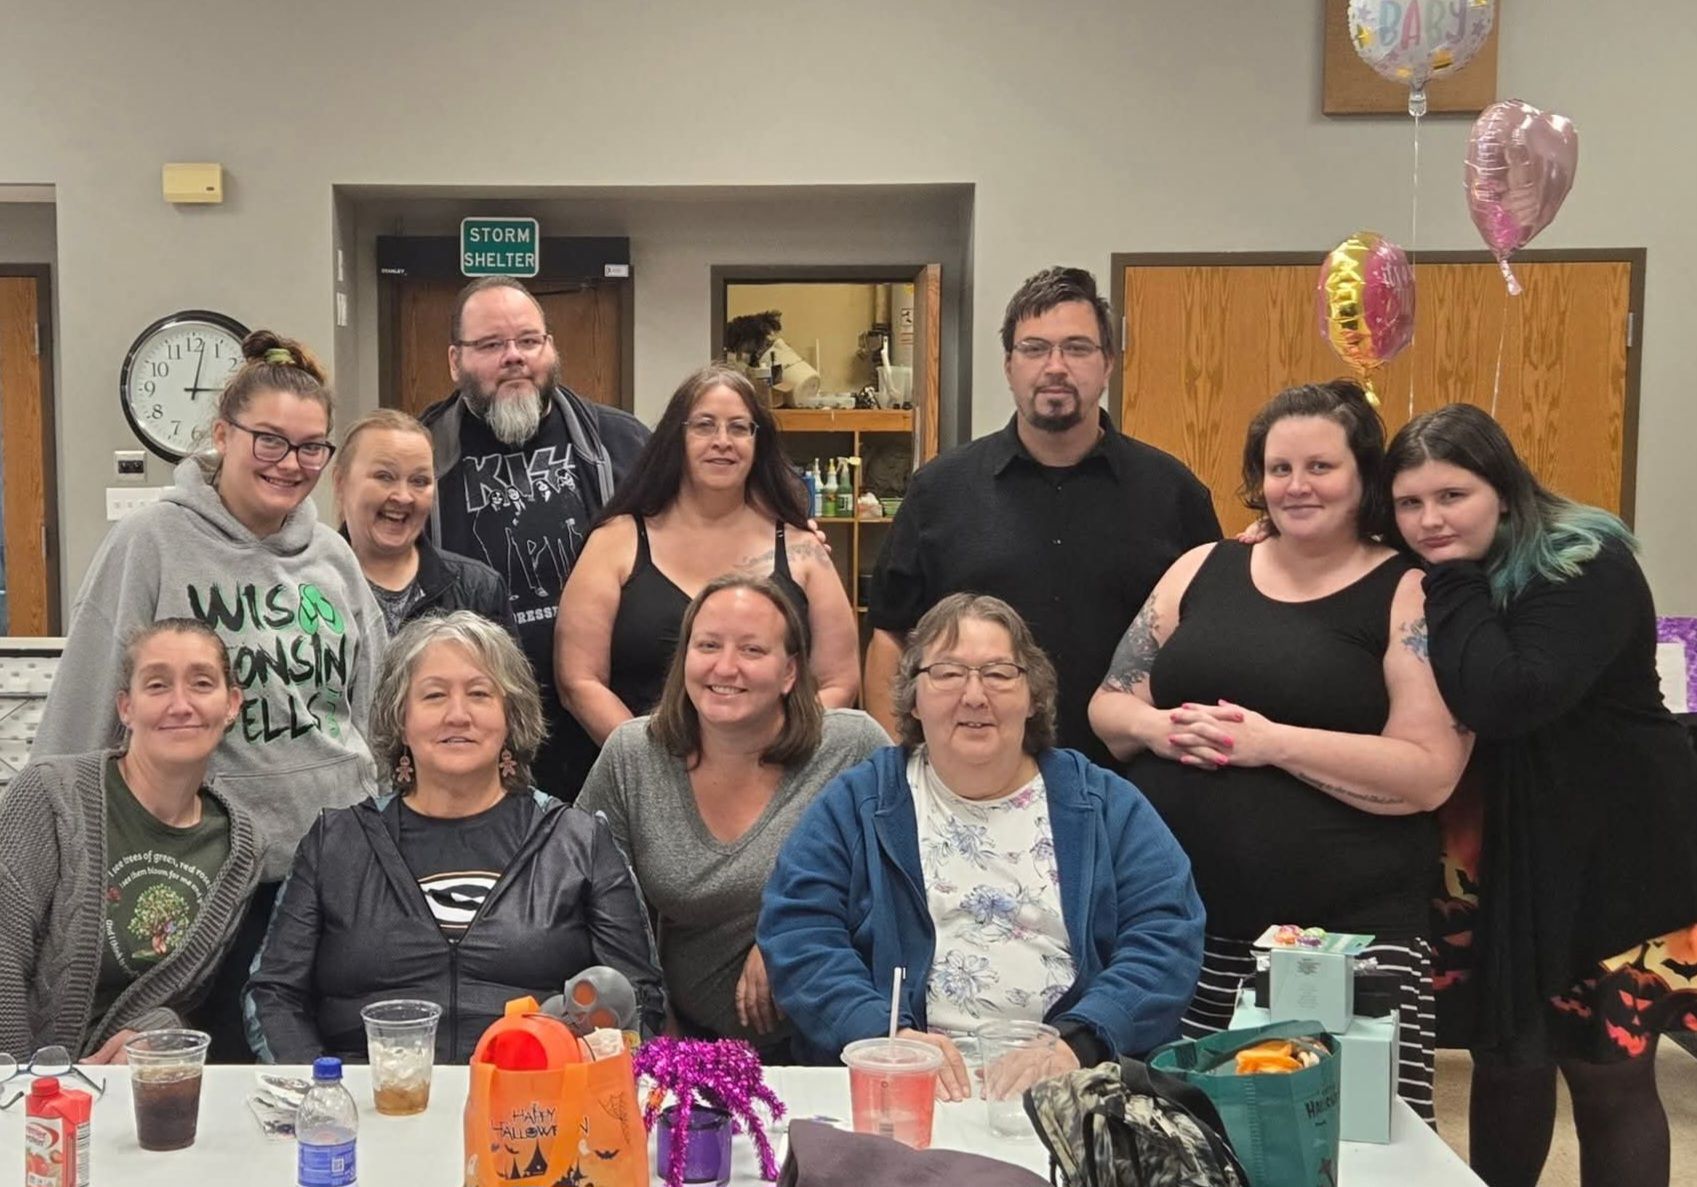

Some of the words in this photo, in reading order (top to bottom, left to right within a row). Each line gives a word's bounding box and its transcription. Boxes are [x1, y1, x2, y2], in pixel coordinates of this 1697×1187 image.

[1378, 0, 1469, 49] BABY
[470, 227, 530, 243] STORM
[464, 252, 535, 268] SHELTER
[167, 344, 181, 360] 11
[186, 337, 203, 353] 12
[151, 362, 169, 377] 10
[228, 358, 238, 373] 2
[144, 381, 155, 397] 9
[152, 404, 163, 419] 8
[170, 421, 181, 436] 7
[463, 443, 576, 513] KISS
[513, 606, 558, 624] RESS
[143, 849, 153, 863] of
[180, 861, 196, 874] red
[168, 870, 180, 880] for
